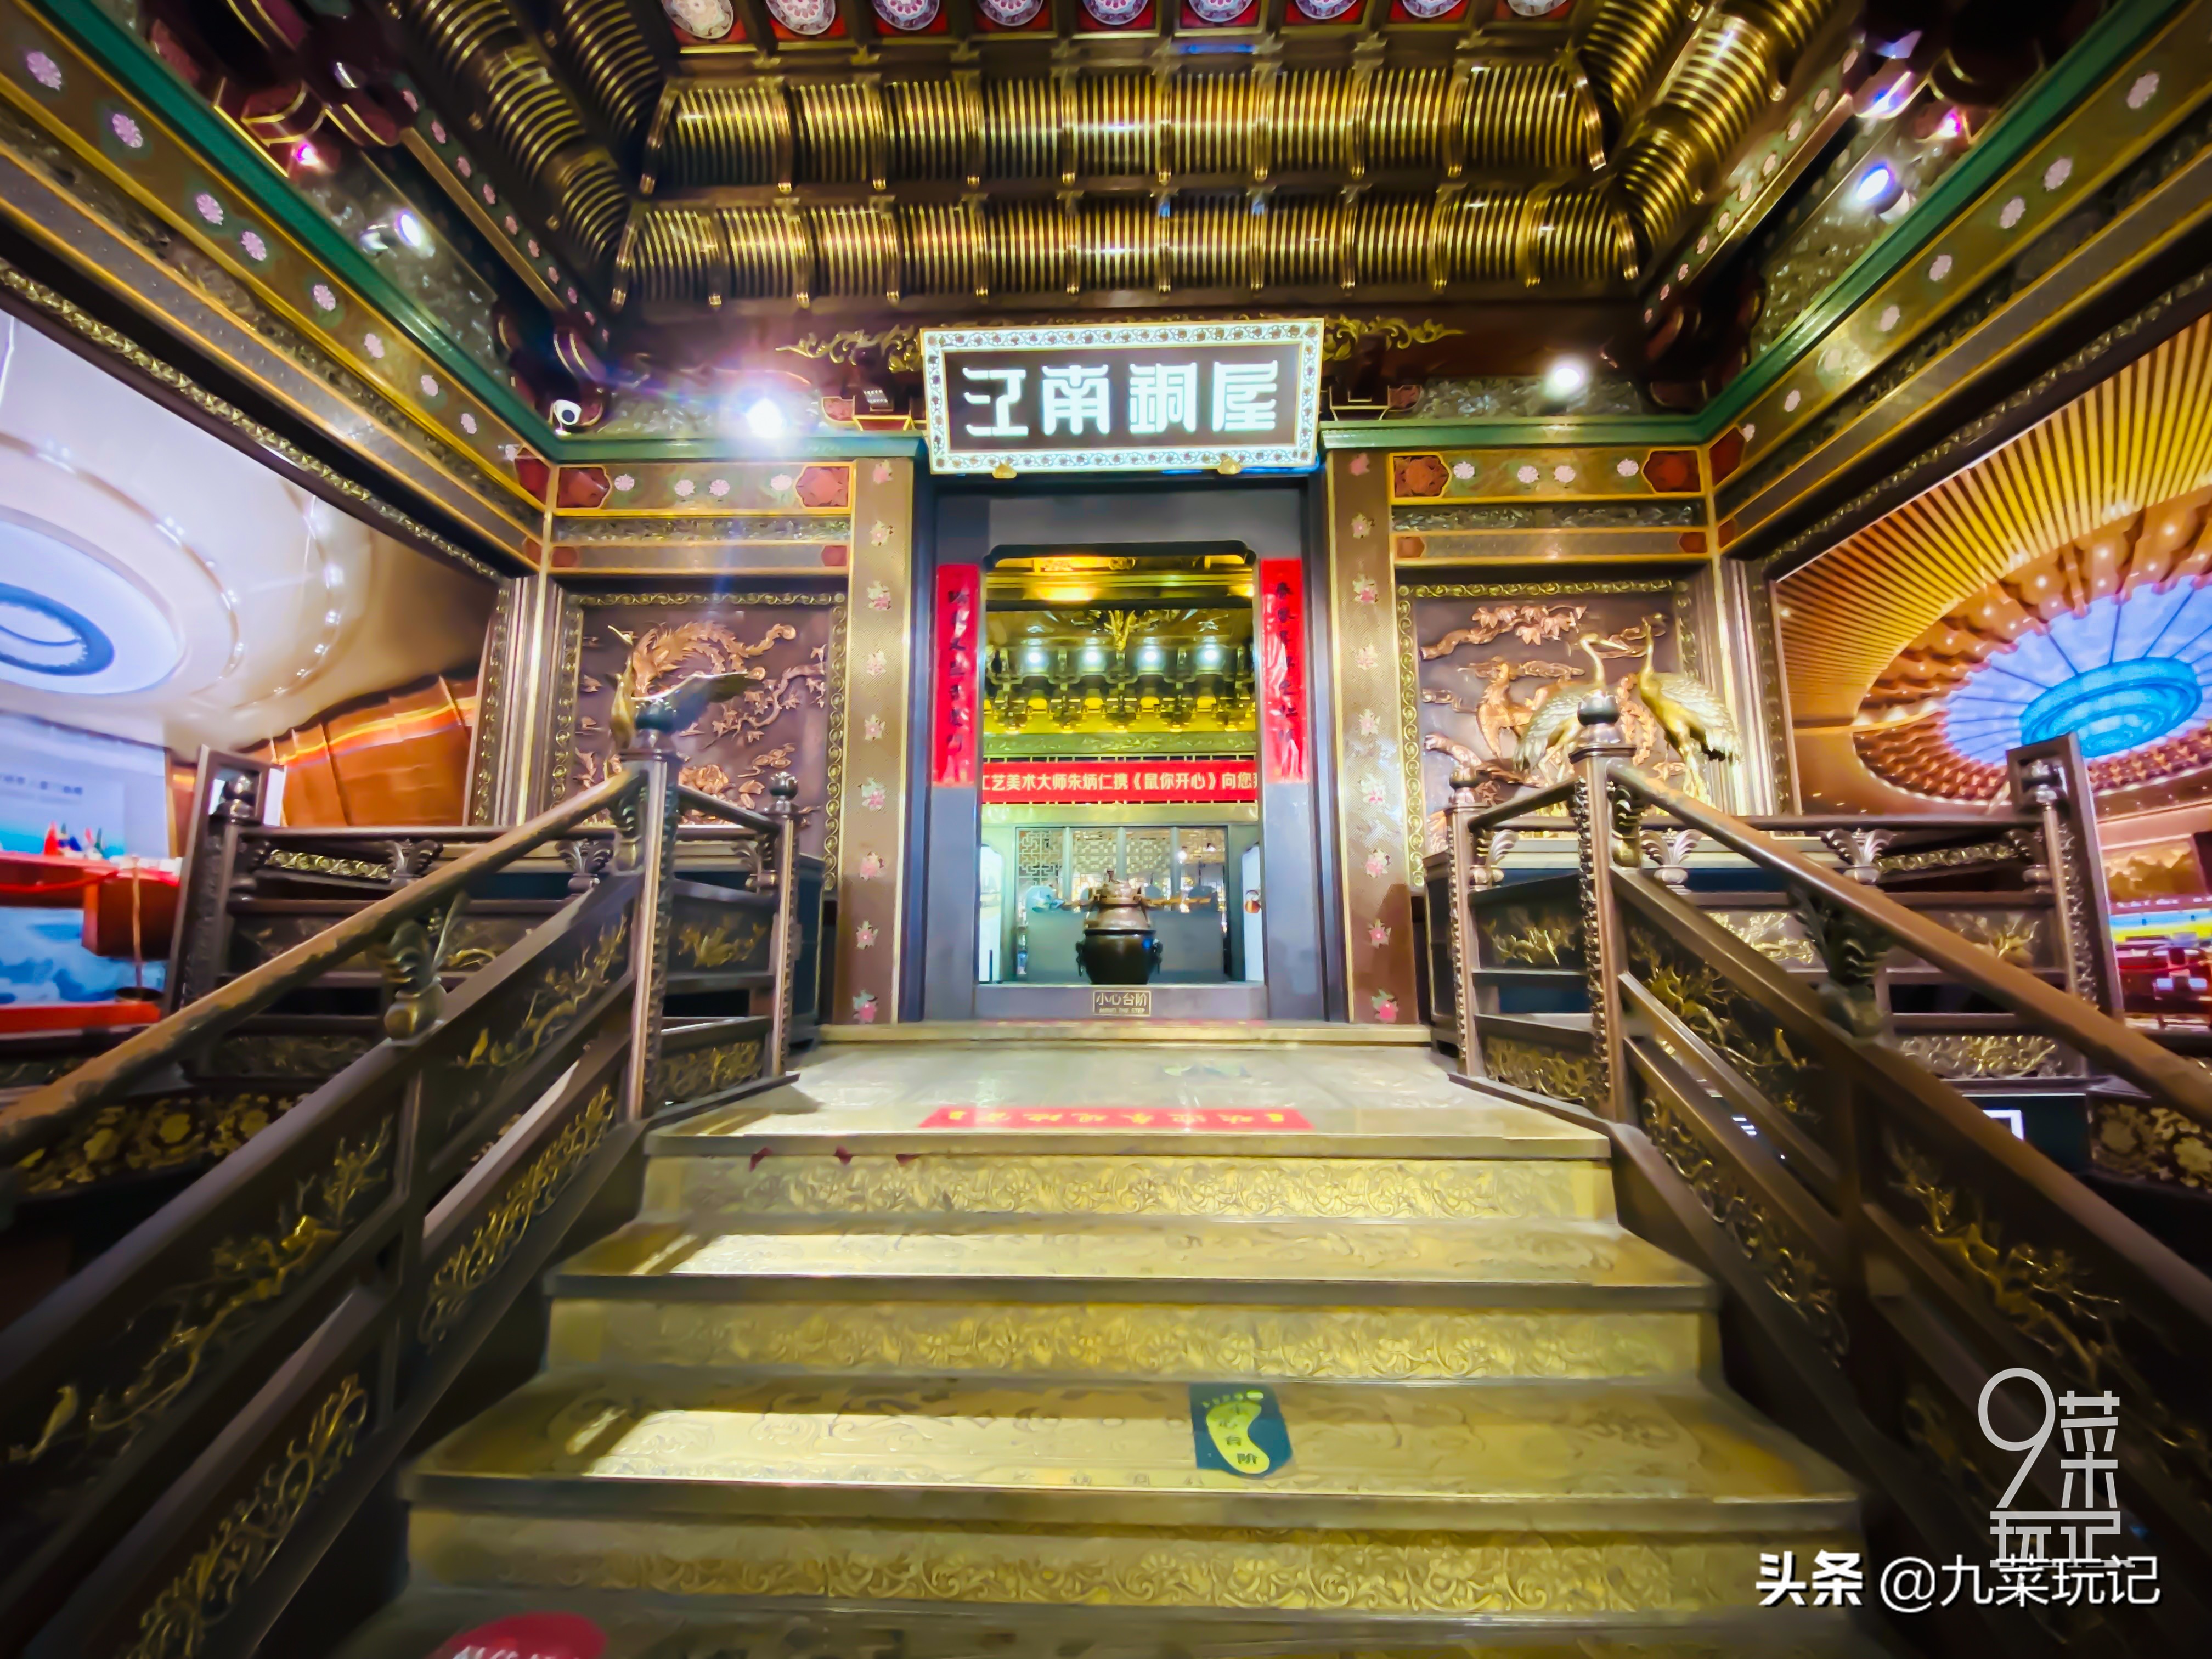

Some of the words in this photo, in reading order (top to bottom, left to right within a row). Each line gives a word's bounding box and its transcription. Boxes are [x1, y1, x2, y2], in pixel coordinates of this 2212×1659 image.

[982, 772, 1257, 791] 工艺美术大师朱炳仁携《鼠你开心》向您
[1096, 992, 1148, 1007] 小心台阶
